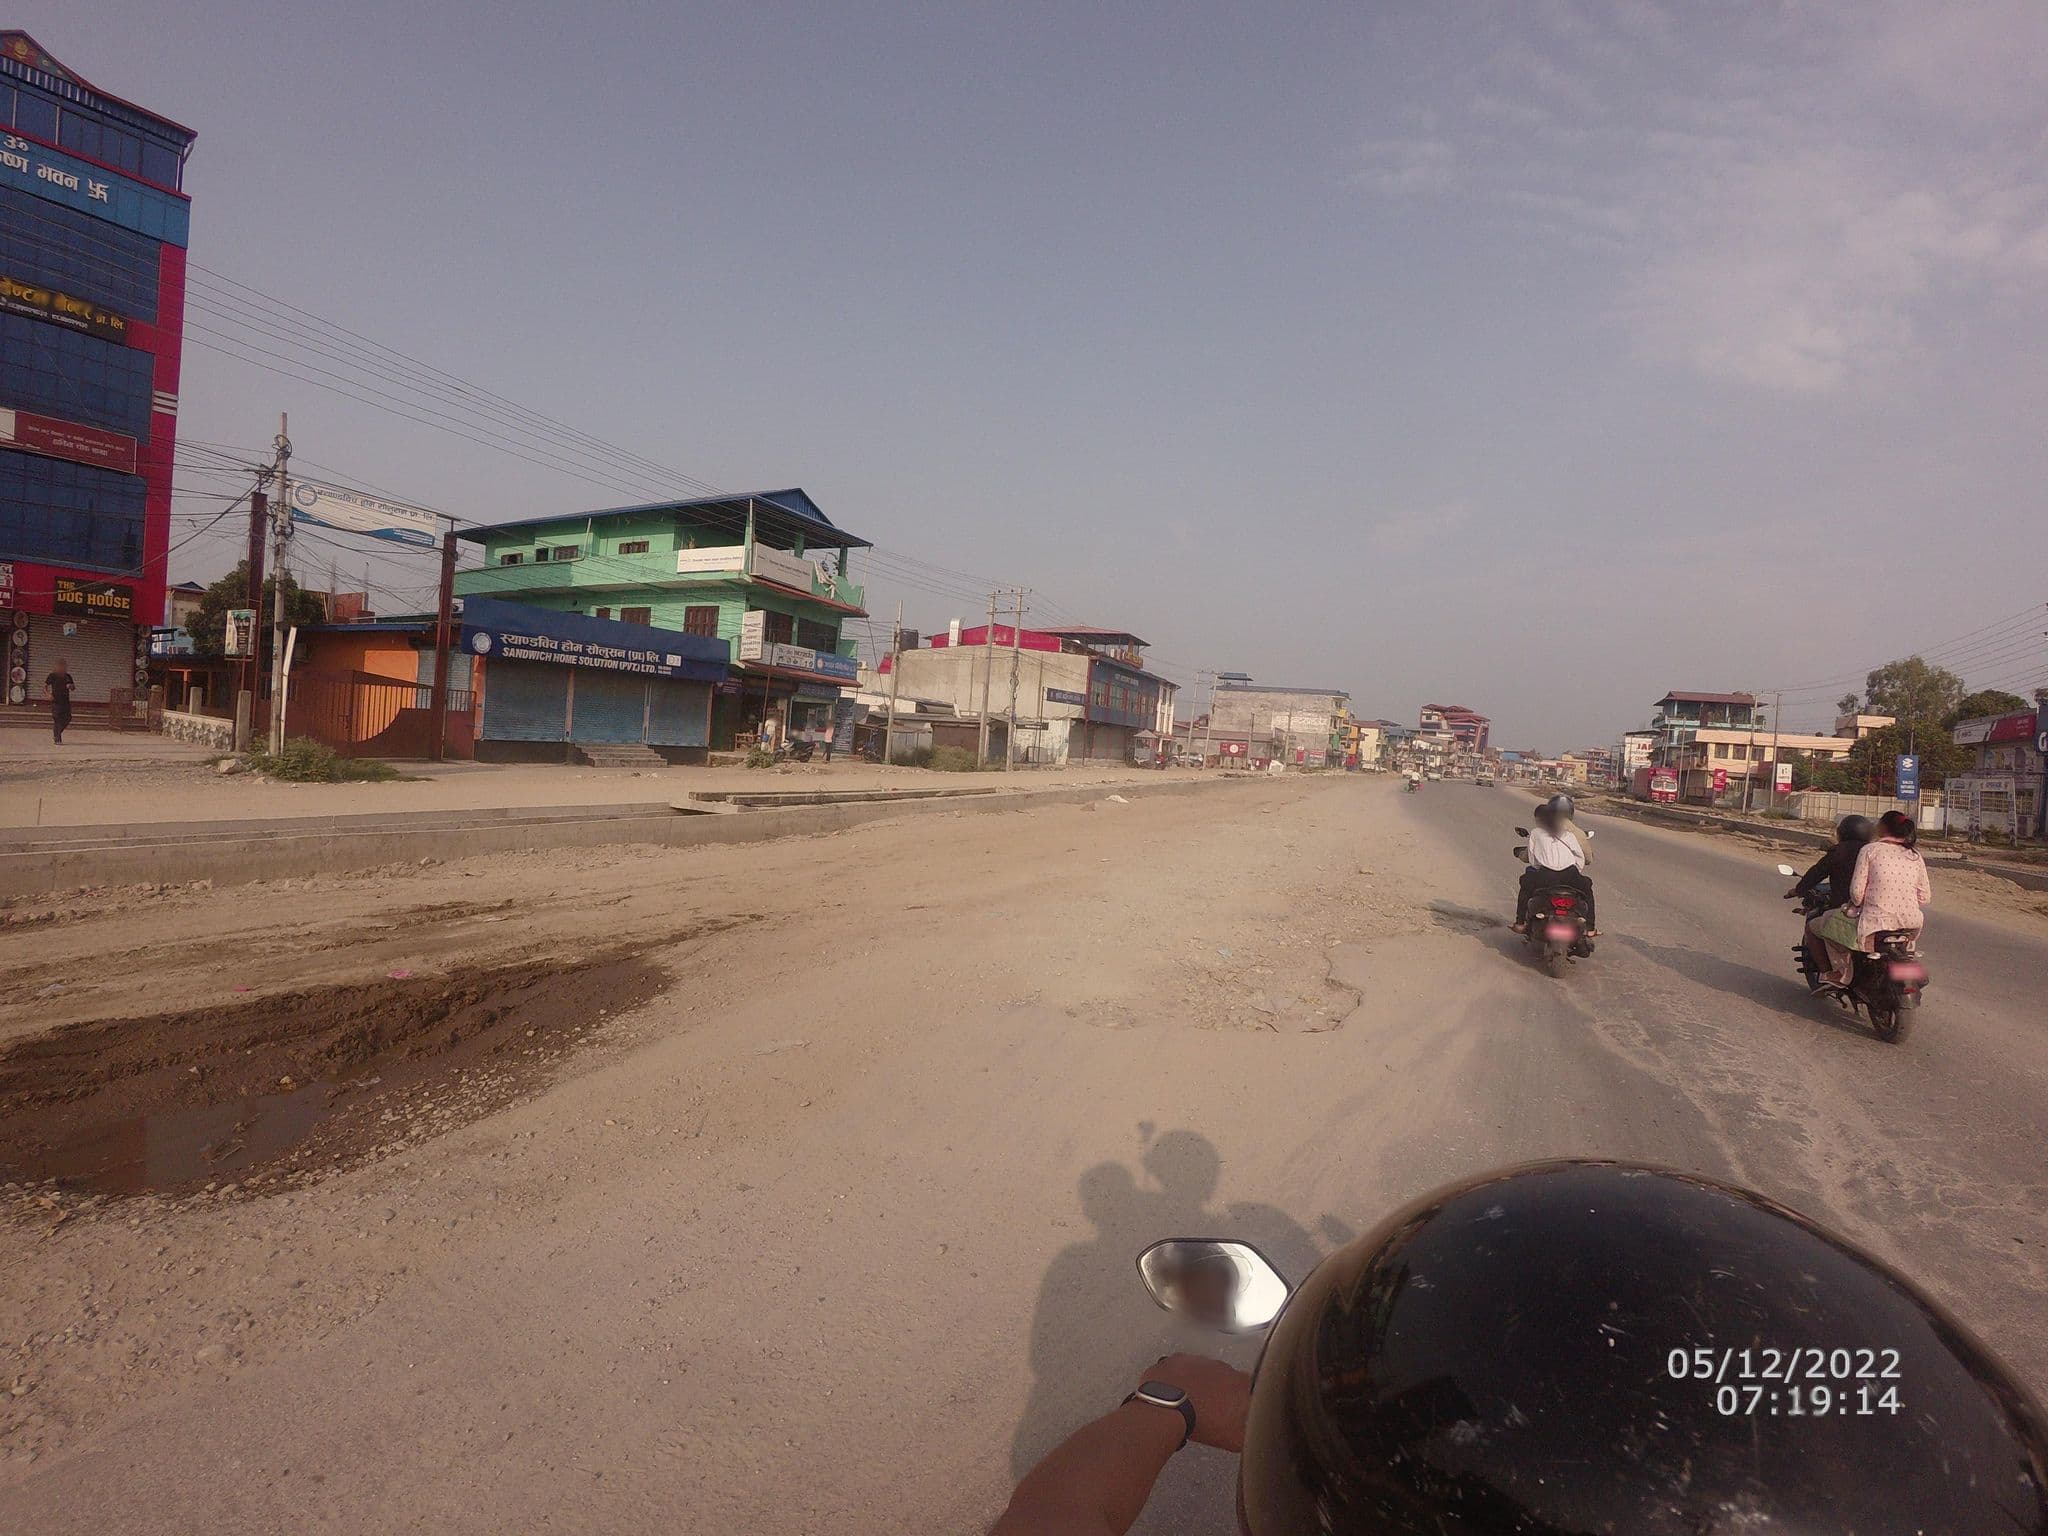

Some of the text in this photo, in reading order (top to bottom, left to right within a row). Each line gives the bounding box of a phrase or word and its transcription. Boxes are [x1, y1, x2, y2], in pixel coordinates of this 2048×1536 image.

[36, 163, 81, 192] भवन
[57, 580, 75, 590] THE
[57, 589, 130, 609] DOG HOUSE
[561, 639, 582, 652] होम
[502, 647, 552, 662] SANDWICH
[553, 653, 578, 665] HOME
[579, 655, 619, 670] SOLUTION
[641, 664, 657, 674] LTD.
